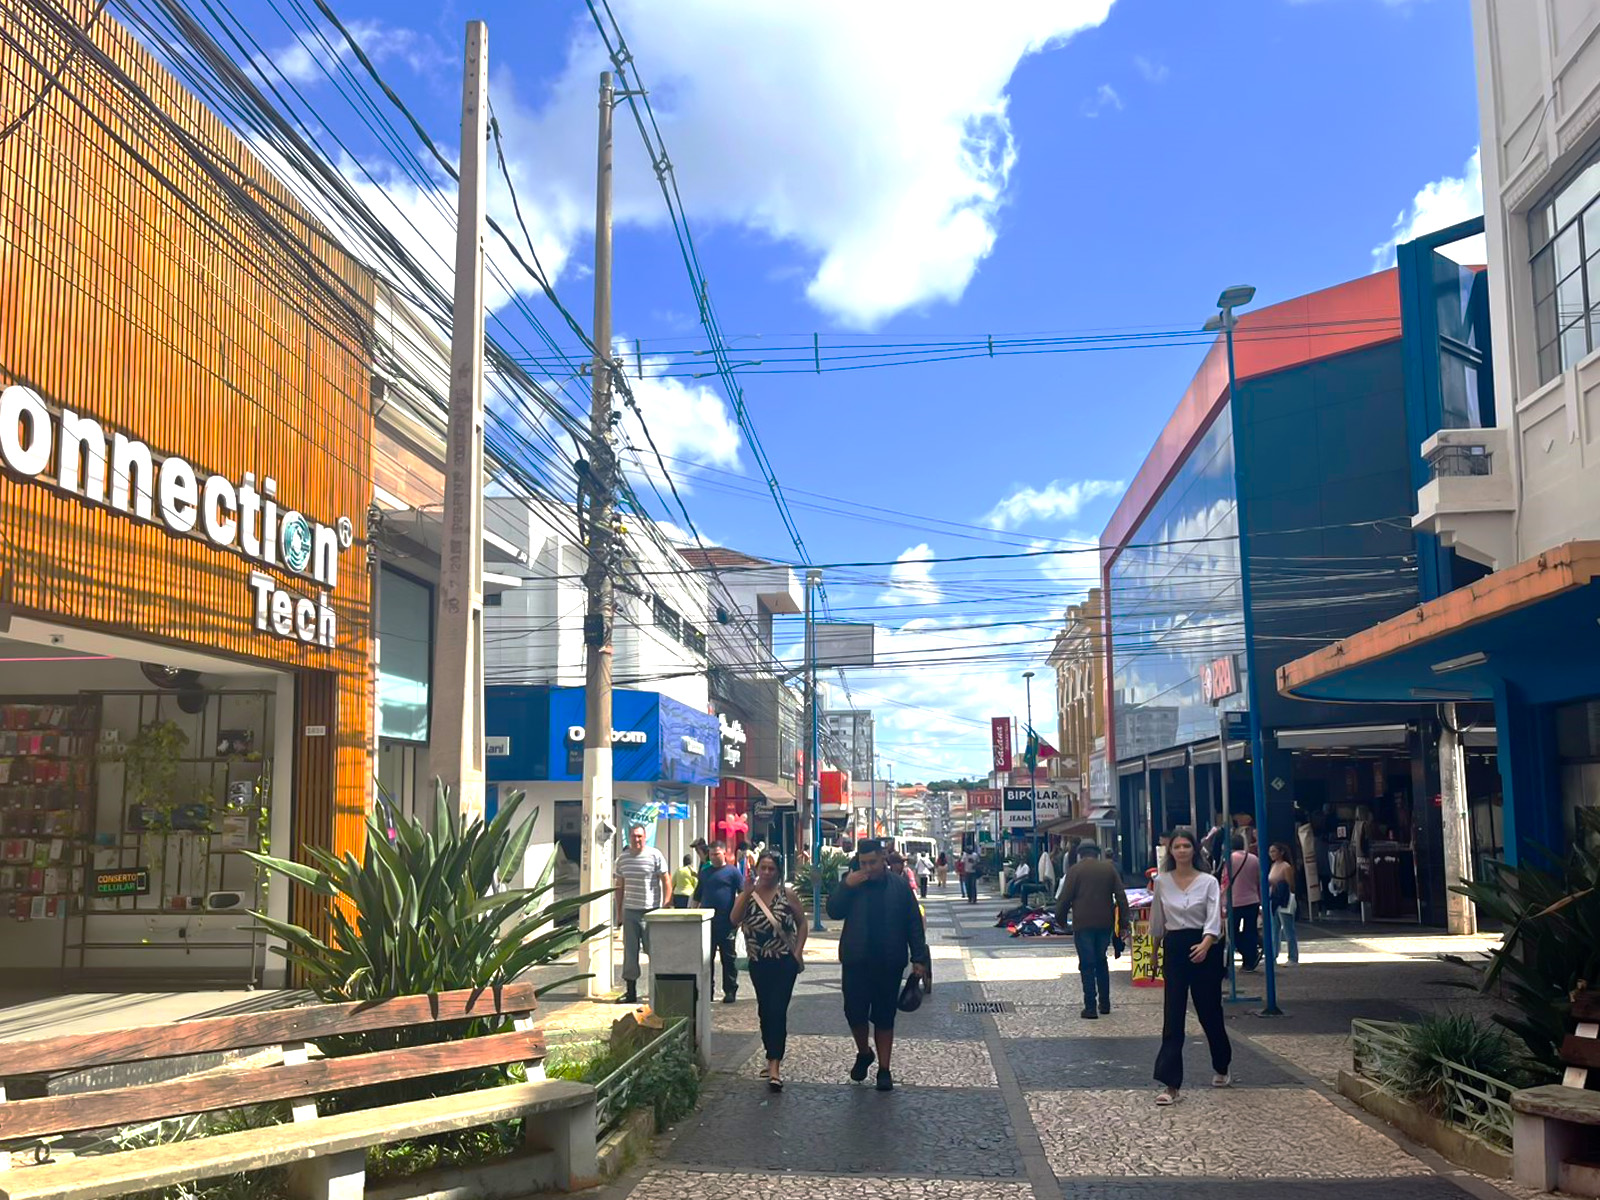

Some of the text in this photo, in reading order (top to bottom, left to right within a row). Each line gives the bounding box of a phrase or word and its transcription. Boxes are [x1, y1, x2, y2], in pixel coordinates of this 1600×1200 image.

[251, 571, 336, 648] Tech
[568, 726, 647, 743] Obom
[97, 873, 137, 883] CONSERTO
[1132, 945, 1143, 962] 3
